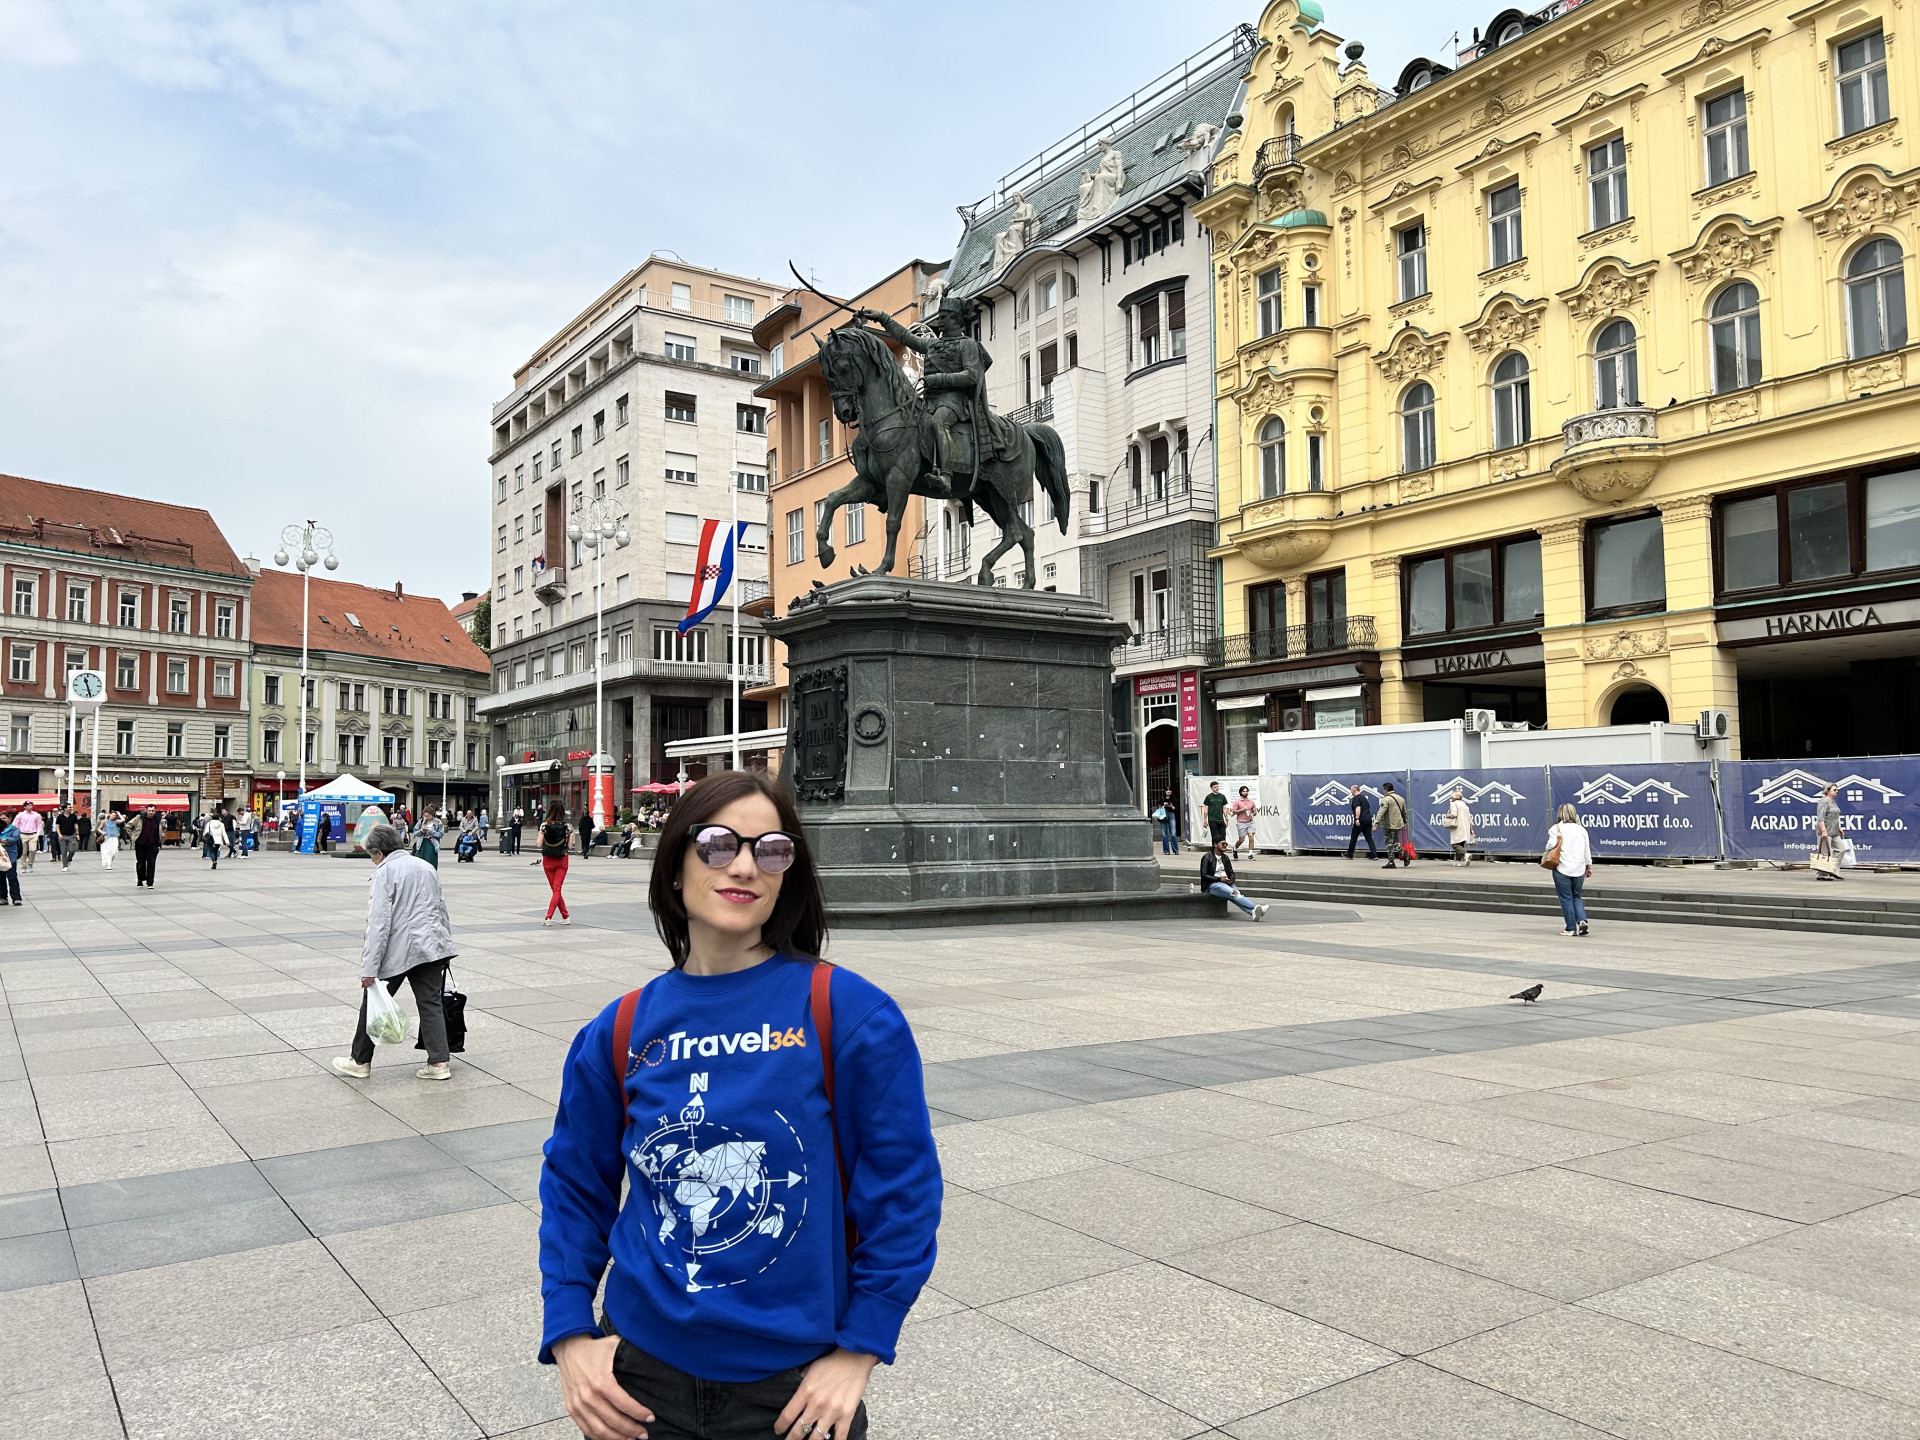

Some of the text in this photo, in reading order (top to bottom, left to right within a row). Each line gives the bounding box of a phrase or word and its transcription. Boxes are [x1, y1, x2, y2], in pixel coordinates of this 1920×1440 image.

[1765, 606, 1882, 636] HARMICA
[1434, 650, 1512, 674] HARMICA
[1256, 668, 1336, 687] Galerija Mala
[1158, 681, 1177, 690] PROSTORA
[130, 775, 191, 785] HOLDING
[1307, 814, 1335, 827] AGRAD
[1503, 814, 1530, 827] d.o.o.
[1576, 814, 1693, 831] AGRAD PROJEKT d.o.o.
[1750, 815, 1798, 831] AGRAD
[1867, 815, 1908, 831] d.o.o.
[1599, 838, 1668, 847] info@agradprojekt.hr
[689, 1071, 709, 1094] N
[685, 1110, 700, 1120] XII
